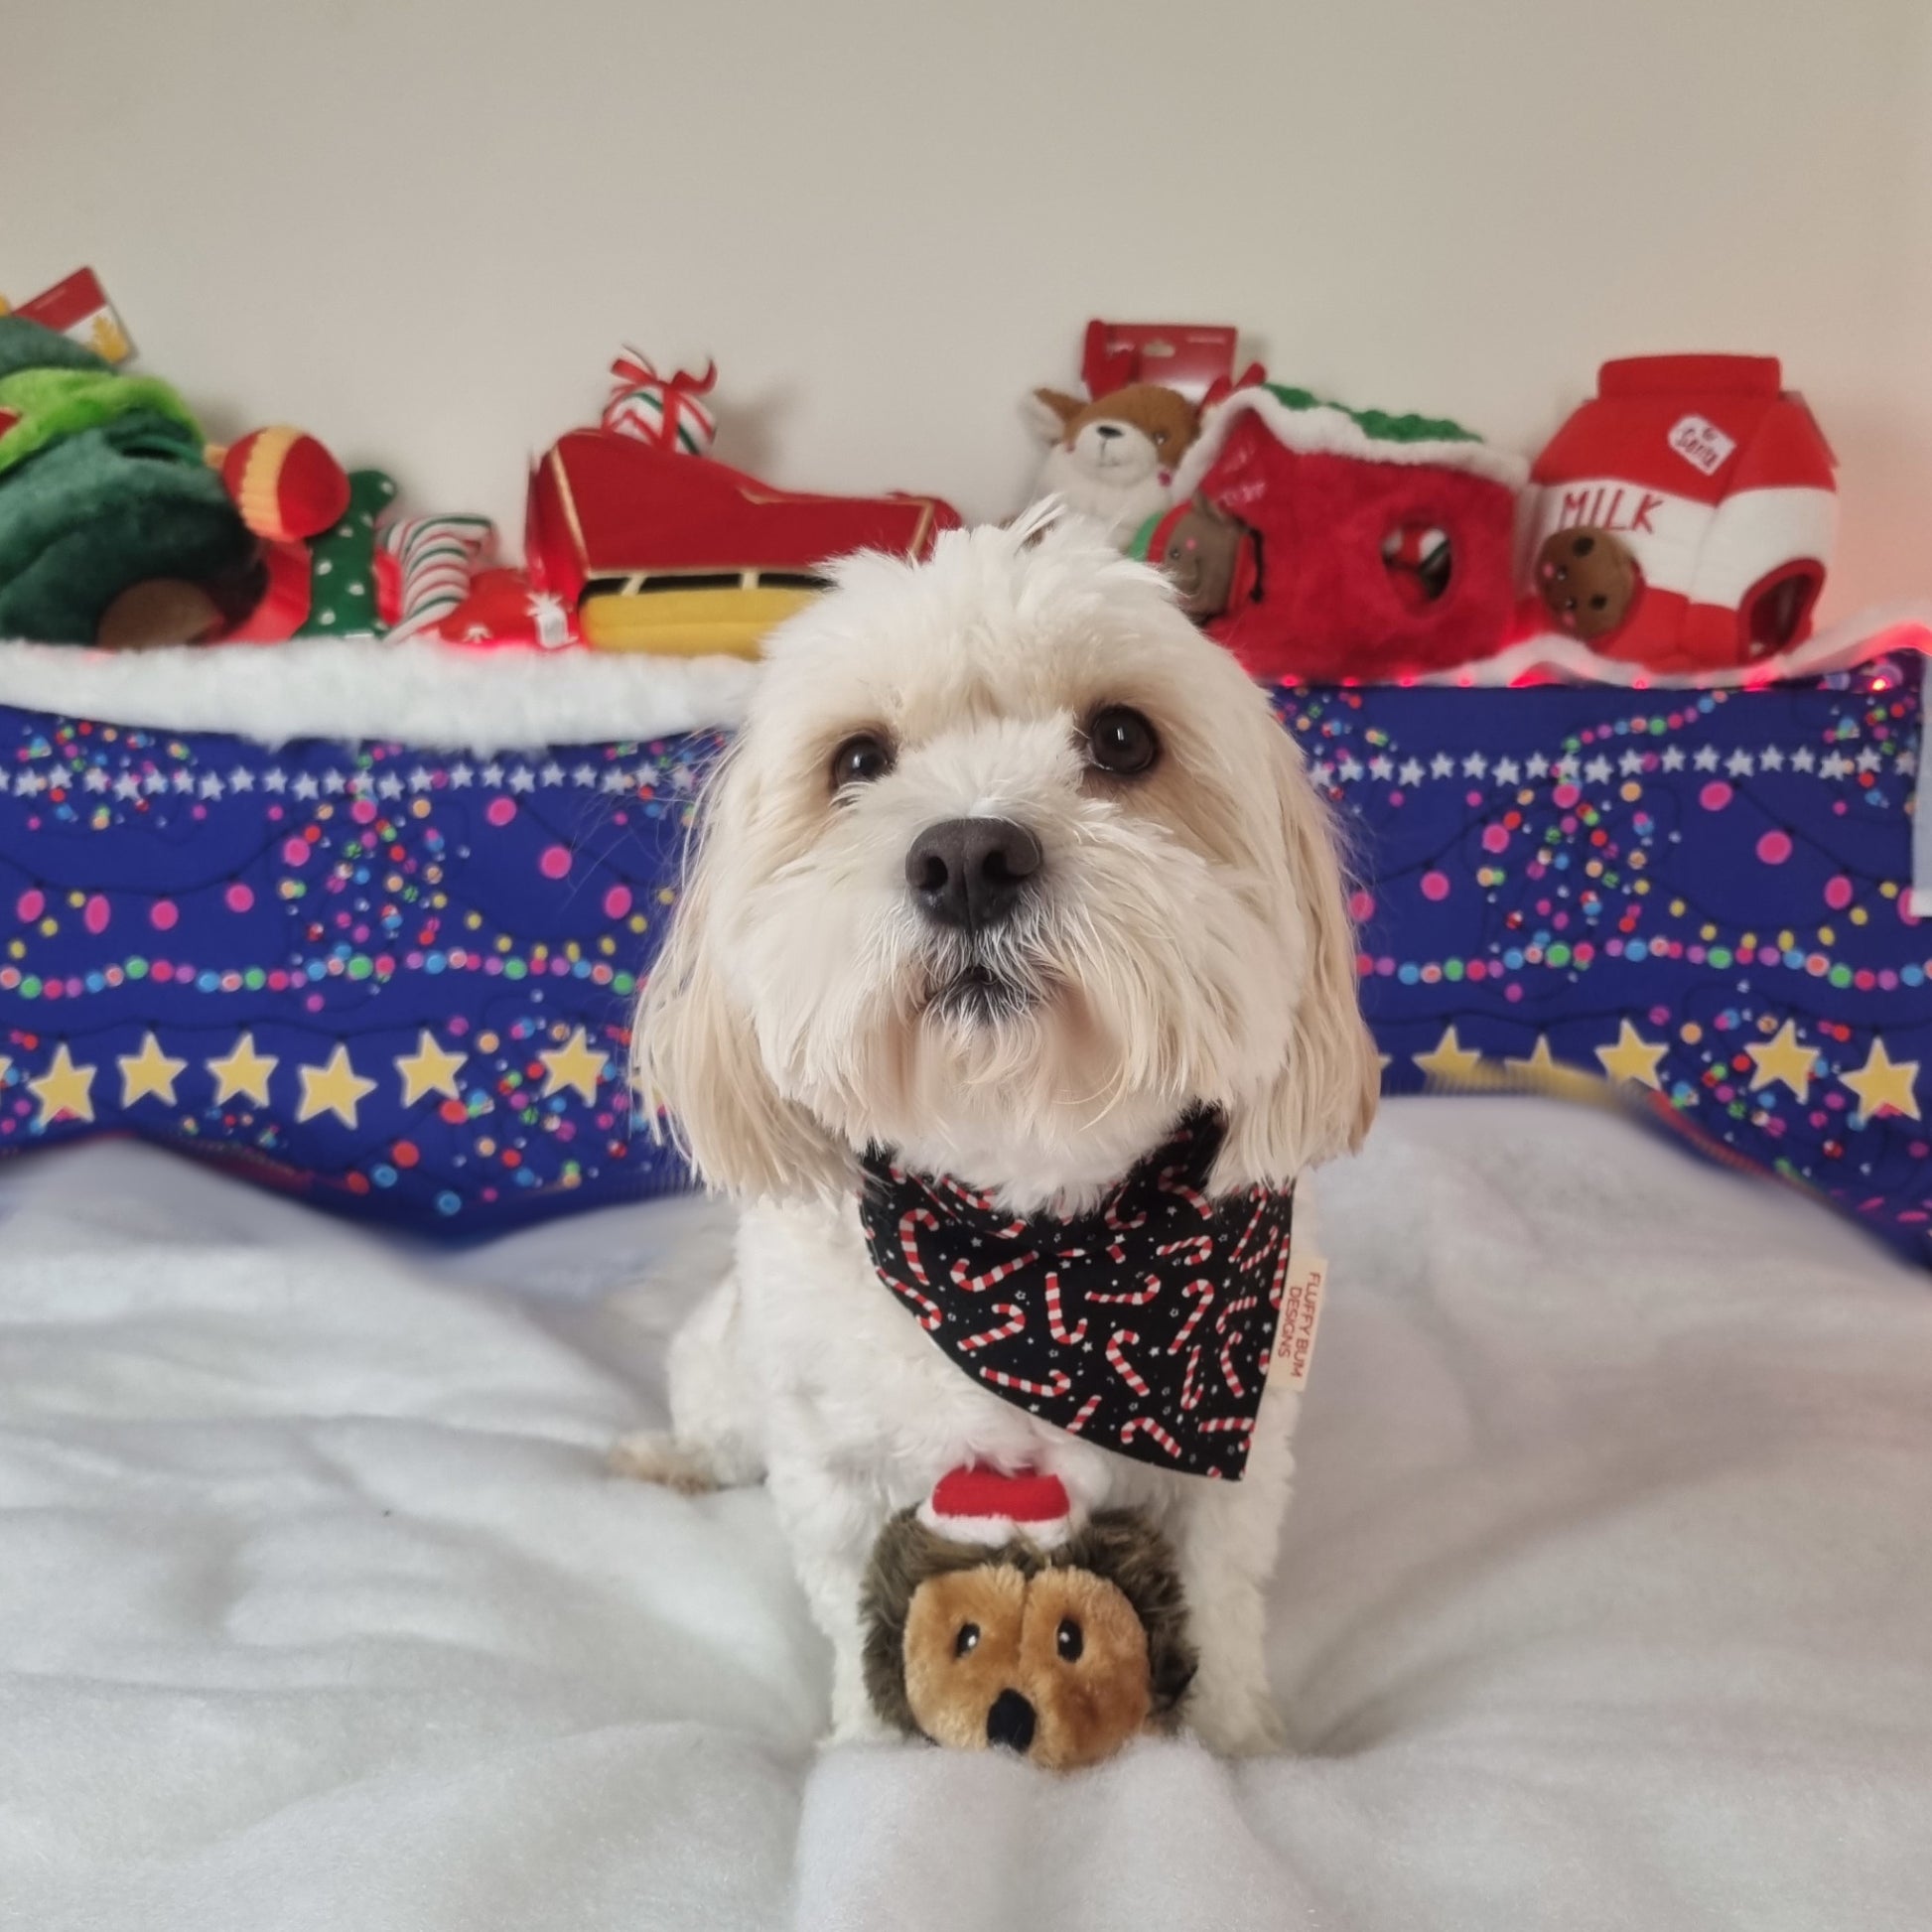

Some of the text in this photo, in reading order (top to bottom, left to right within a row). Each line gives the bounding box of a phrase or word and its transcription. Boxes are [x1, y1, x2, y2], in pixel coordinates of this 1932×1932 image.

[1559, 487, 1663, 534] MILK
[1278, 1286, 1302, 1358] DESIGNS
[1291, 1271, 1320, 1379] FLUFFY BUM
